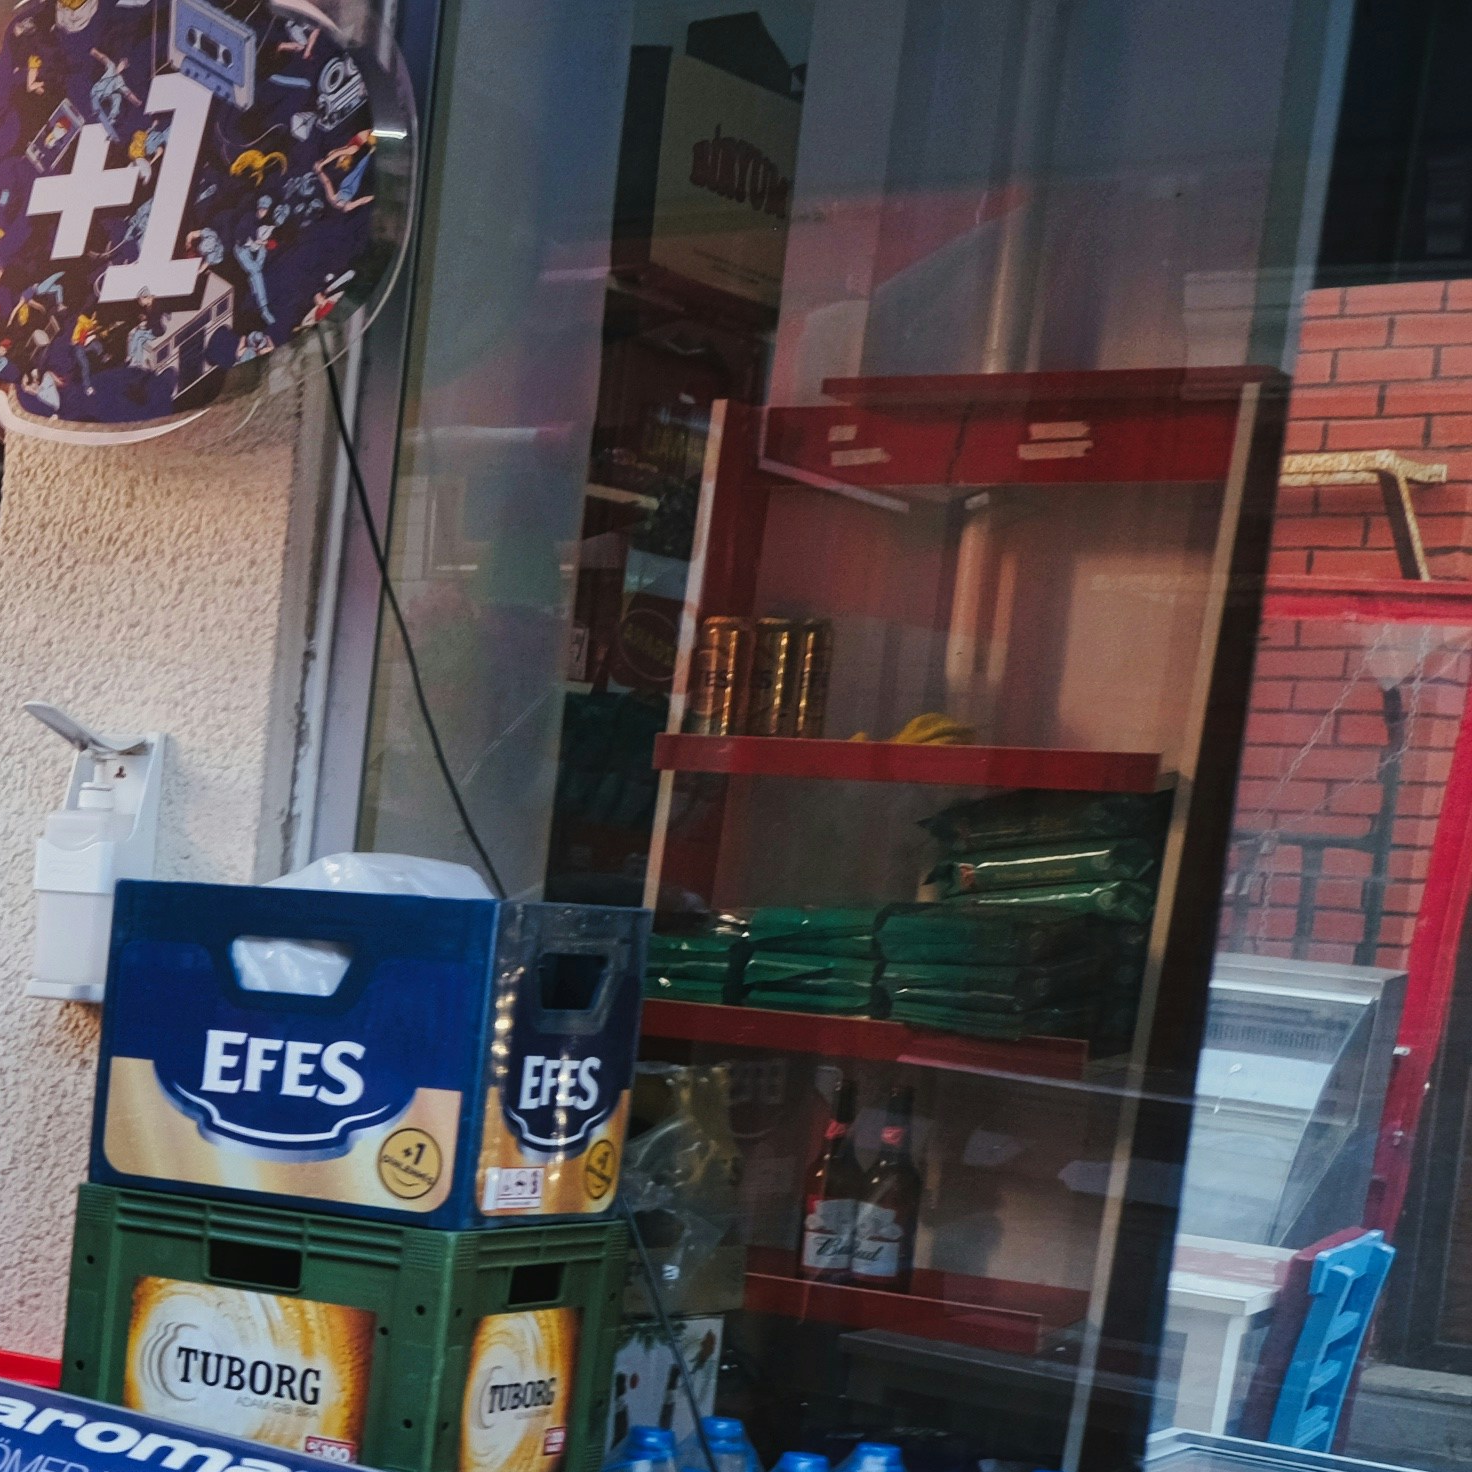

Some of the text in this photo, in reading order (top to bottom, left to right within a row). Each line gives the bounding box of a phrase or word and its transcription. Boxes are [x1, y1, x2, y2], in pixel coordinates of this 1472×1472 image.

[200, 1029, 366, 1107] EFES
[519, 1054, 601, 1112] EFES
[176, 1346, 322, 1406] TUBORG
[488, 1376, 556, 1414] TUBORG
